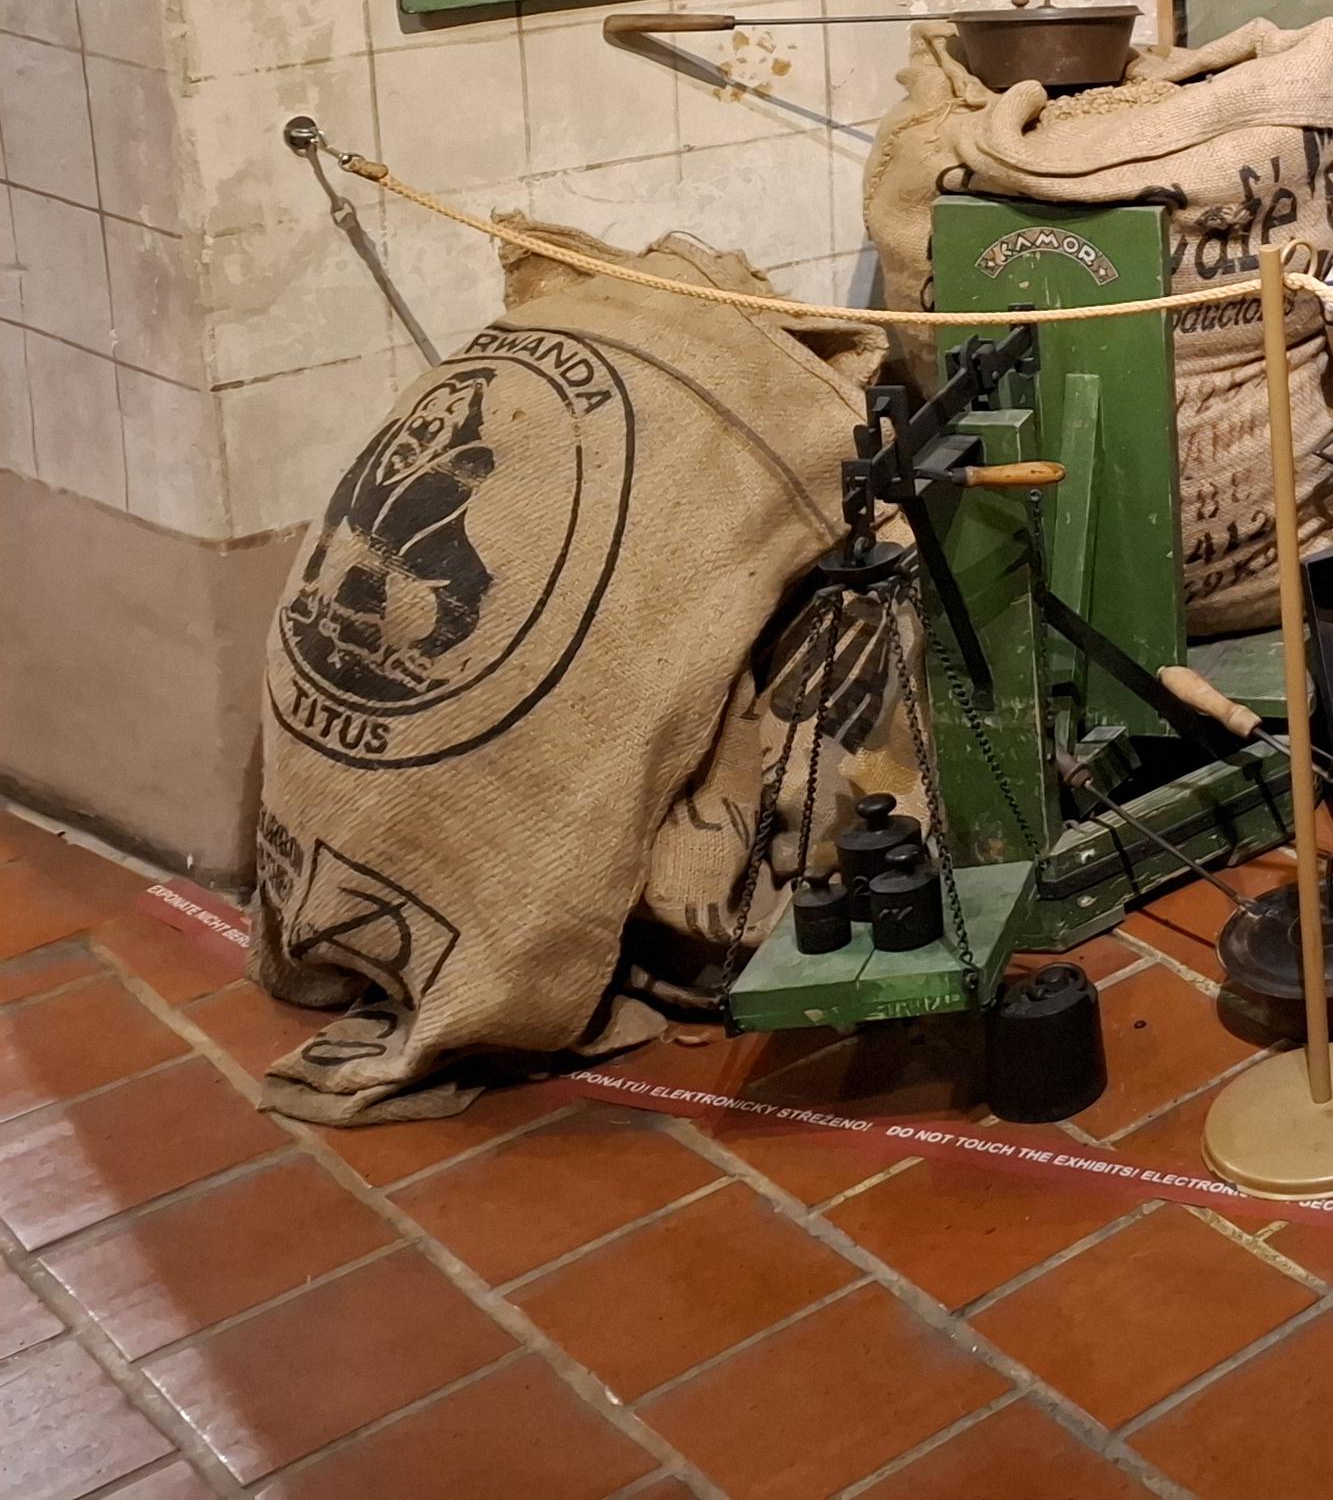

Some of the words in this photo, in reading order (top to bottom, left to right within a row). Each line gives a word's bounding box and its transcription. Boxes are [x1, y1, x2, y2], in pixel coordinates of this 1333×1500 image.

[465, 333, 613, 414] RWANDA
[289, 680, 391, 754] TITUS
[146, 884, 203, 916] EXPONATE
[195, 910, 231, 933] NICHT
[650, 1086, 778, 1115] ELEKTRONICKY
[776, 1107, 874, 1132] STŘEŽENO!
[886, 1125, 914, 1138] DO
[914, 1130, 953, 1145] NOT
[955, 1137, 1016, 1156] TOUCH
[1017, 1147, 1053, 1163] THE
[1053, 1154, 1140, 1178] EXHIBITS!
